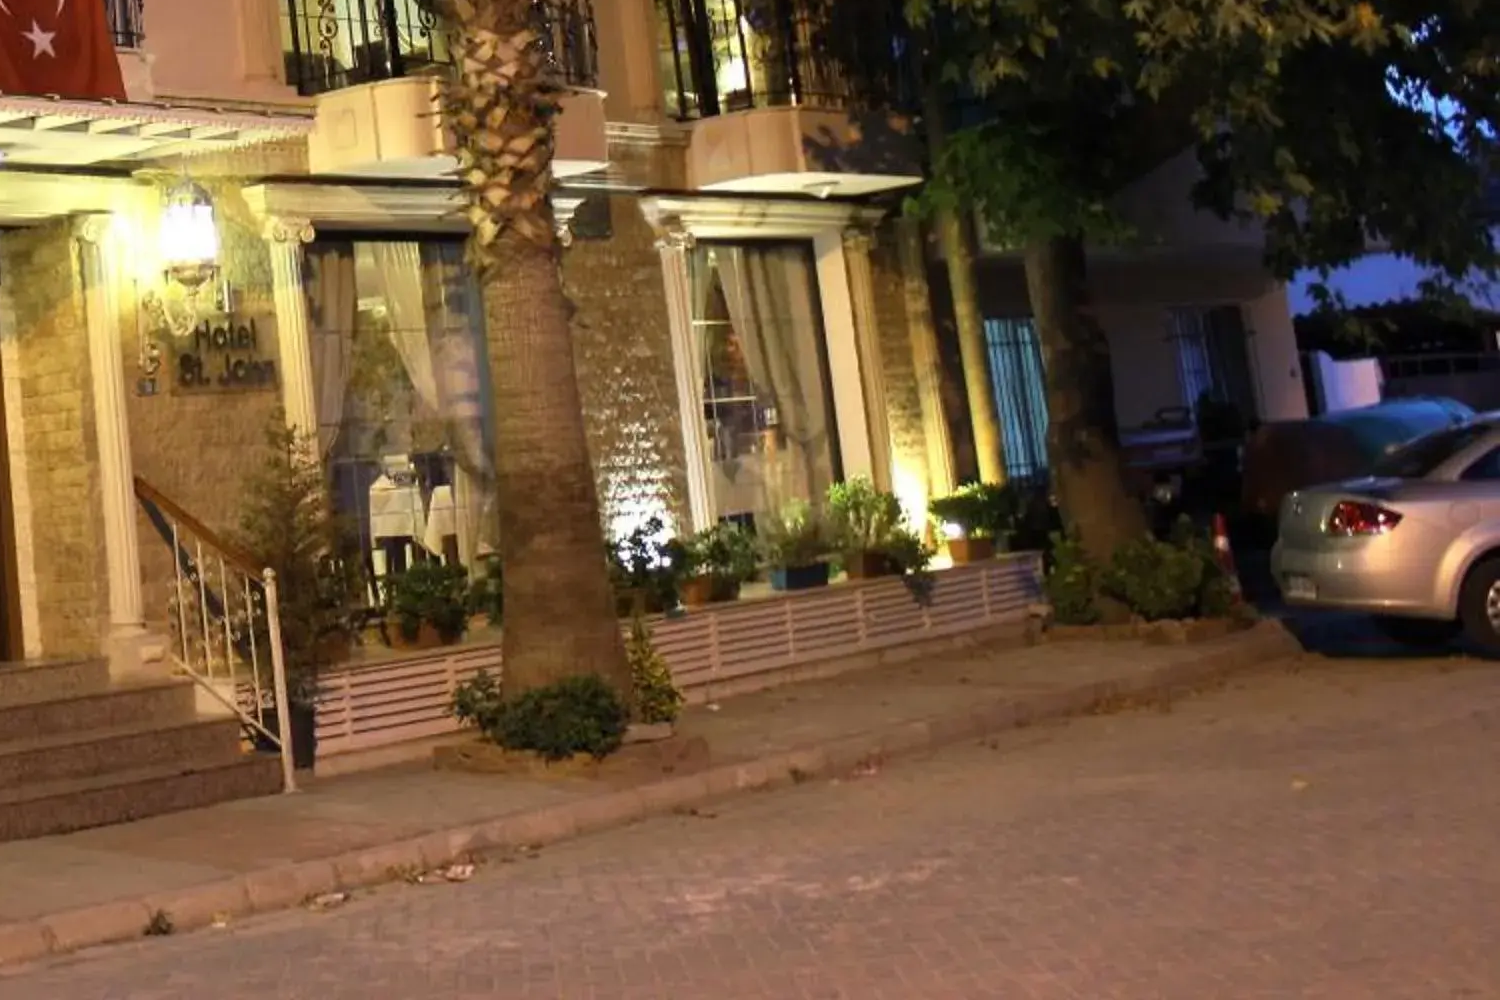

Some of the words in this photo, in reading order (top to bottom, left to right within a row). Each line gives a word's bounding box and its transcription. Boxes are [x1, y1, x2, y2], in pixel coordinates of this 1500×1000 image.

[194, 316, 257, 351] Hotel
[177, 352, 210, 387] St.
[217, 352, 277, 387] John
